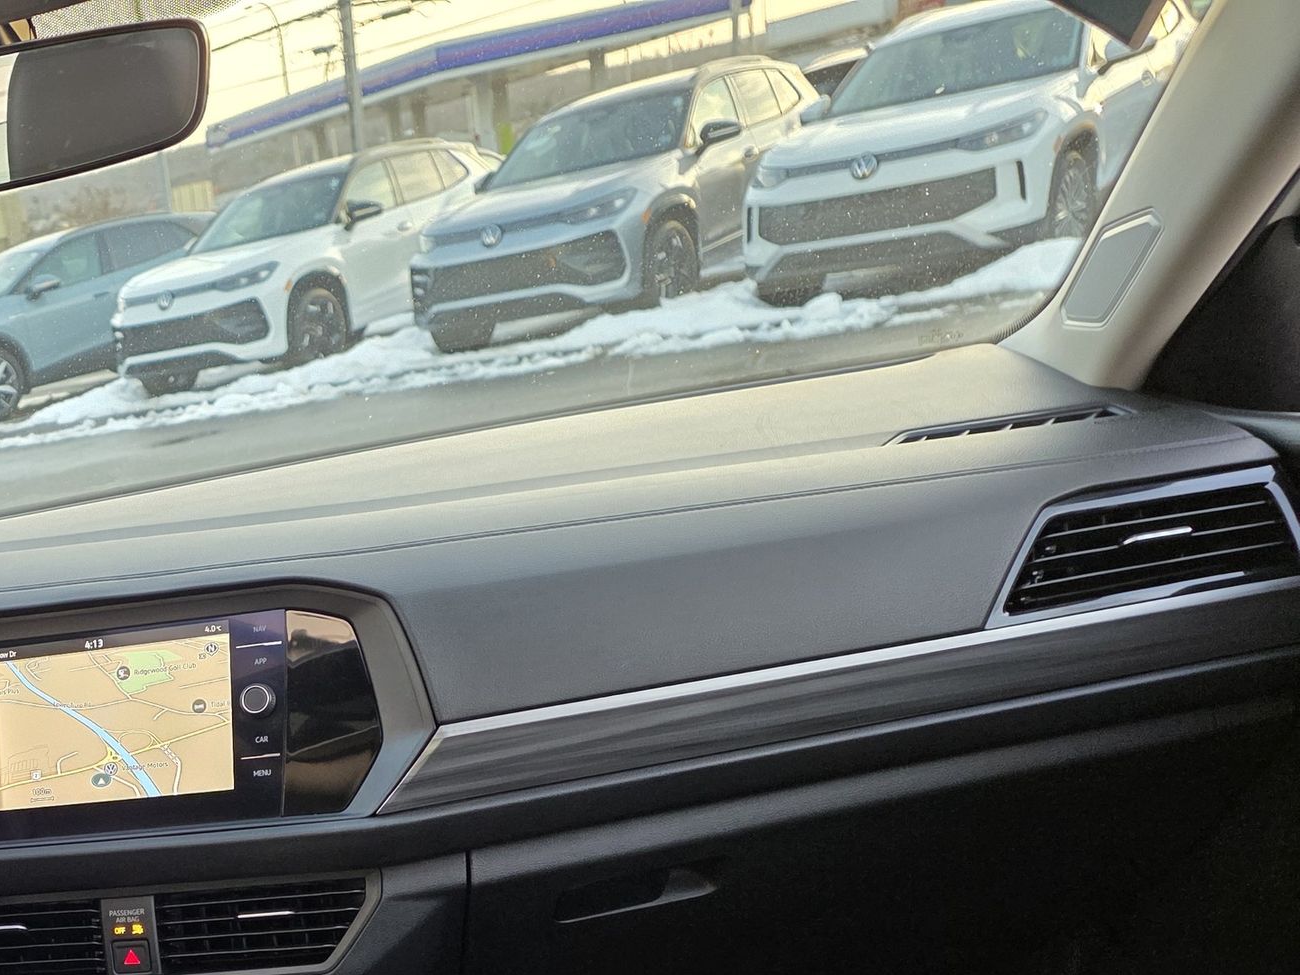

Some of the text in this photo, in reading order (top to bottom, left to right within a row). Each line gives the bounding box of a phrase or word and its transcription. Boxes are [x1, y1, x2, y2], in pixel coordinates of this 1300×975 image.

[253, 625, 267, 633] NAV
[84, 639, 104, 649] 4:13
[9, 650, 17, 658] Dr
[254, 657, 268, 665] APP
[133, 666, 167, 676] Ridgewood
[182, 662, 197, 671] Club
[210, 701, 225, 709] Tidal
[255, 736, 269, 744] CAR
[146, 761, 169, 769] Motors
[253, 769, 272, 777] MENU
[108, 908, 145, 917] PASSENGER
[127, 915, 140, 923] BAG
[114, 926, 126, 935] OFF
